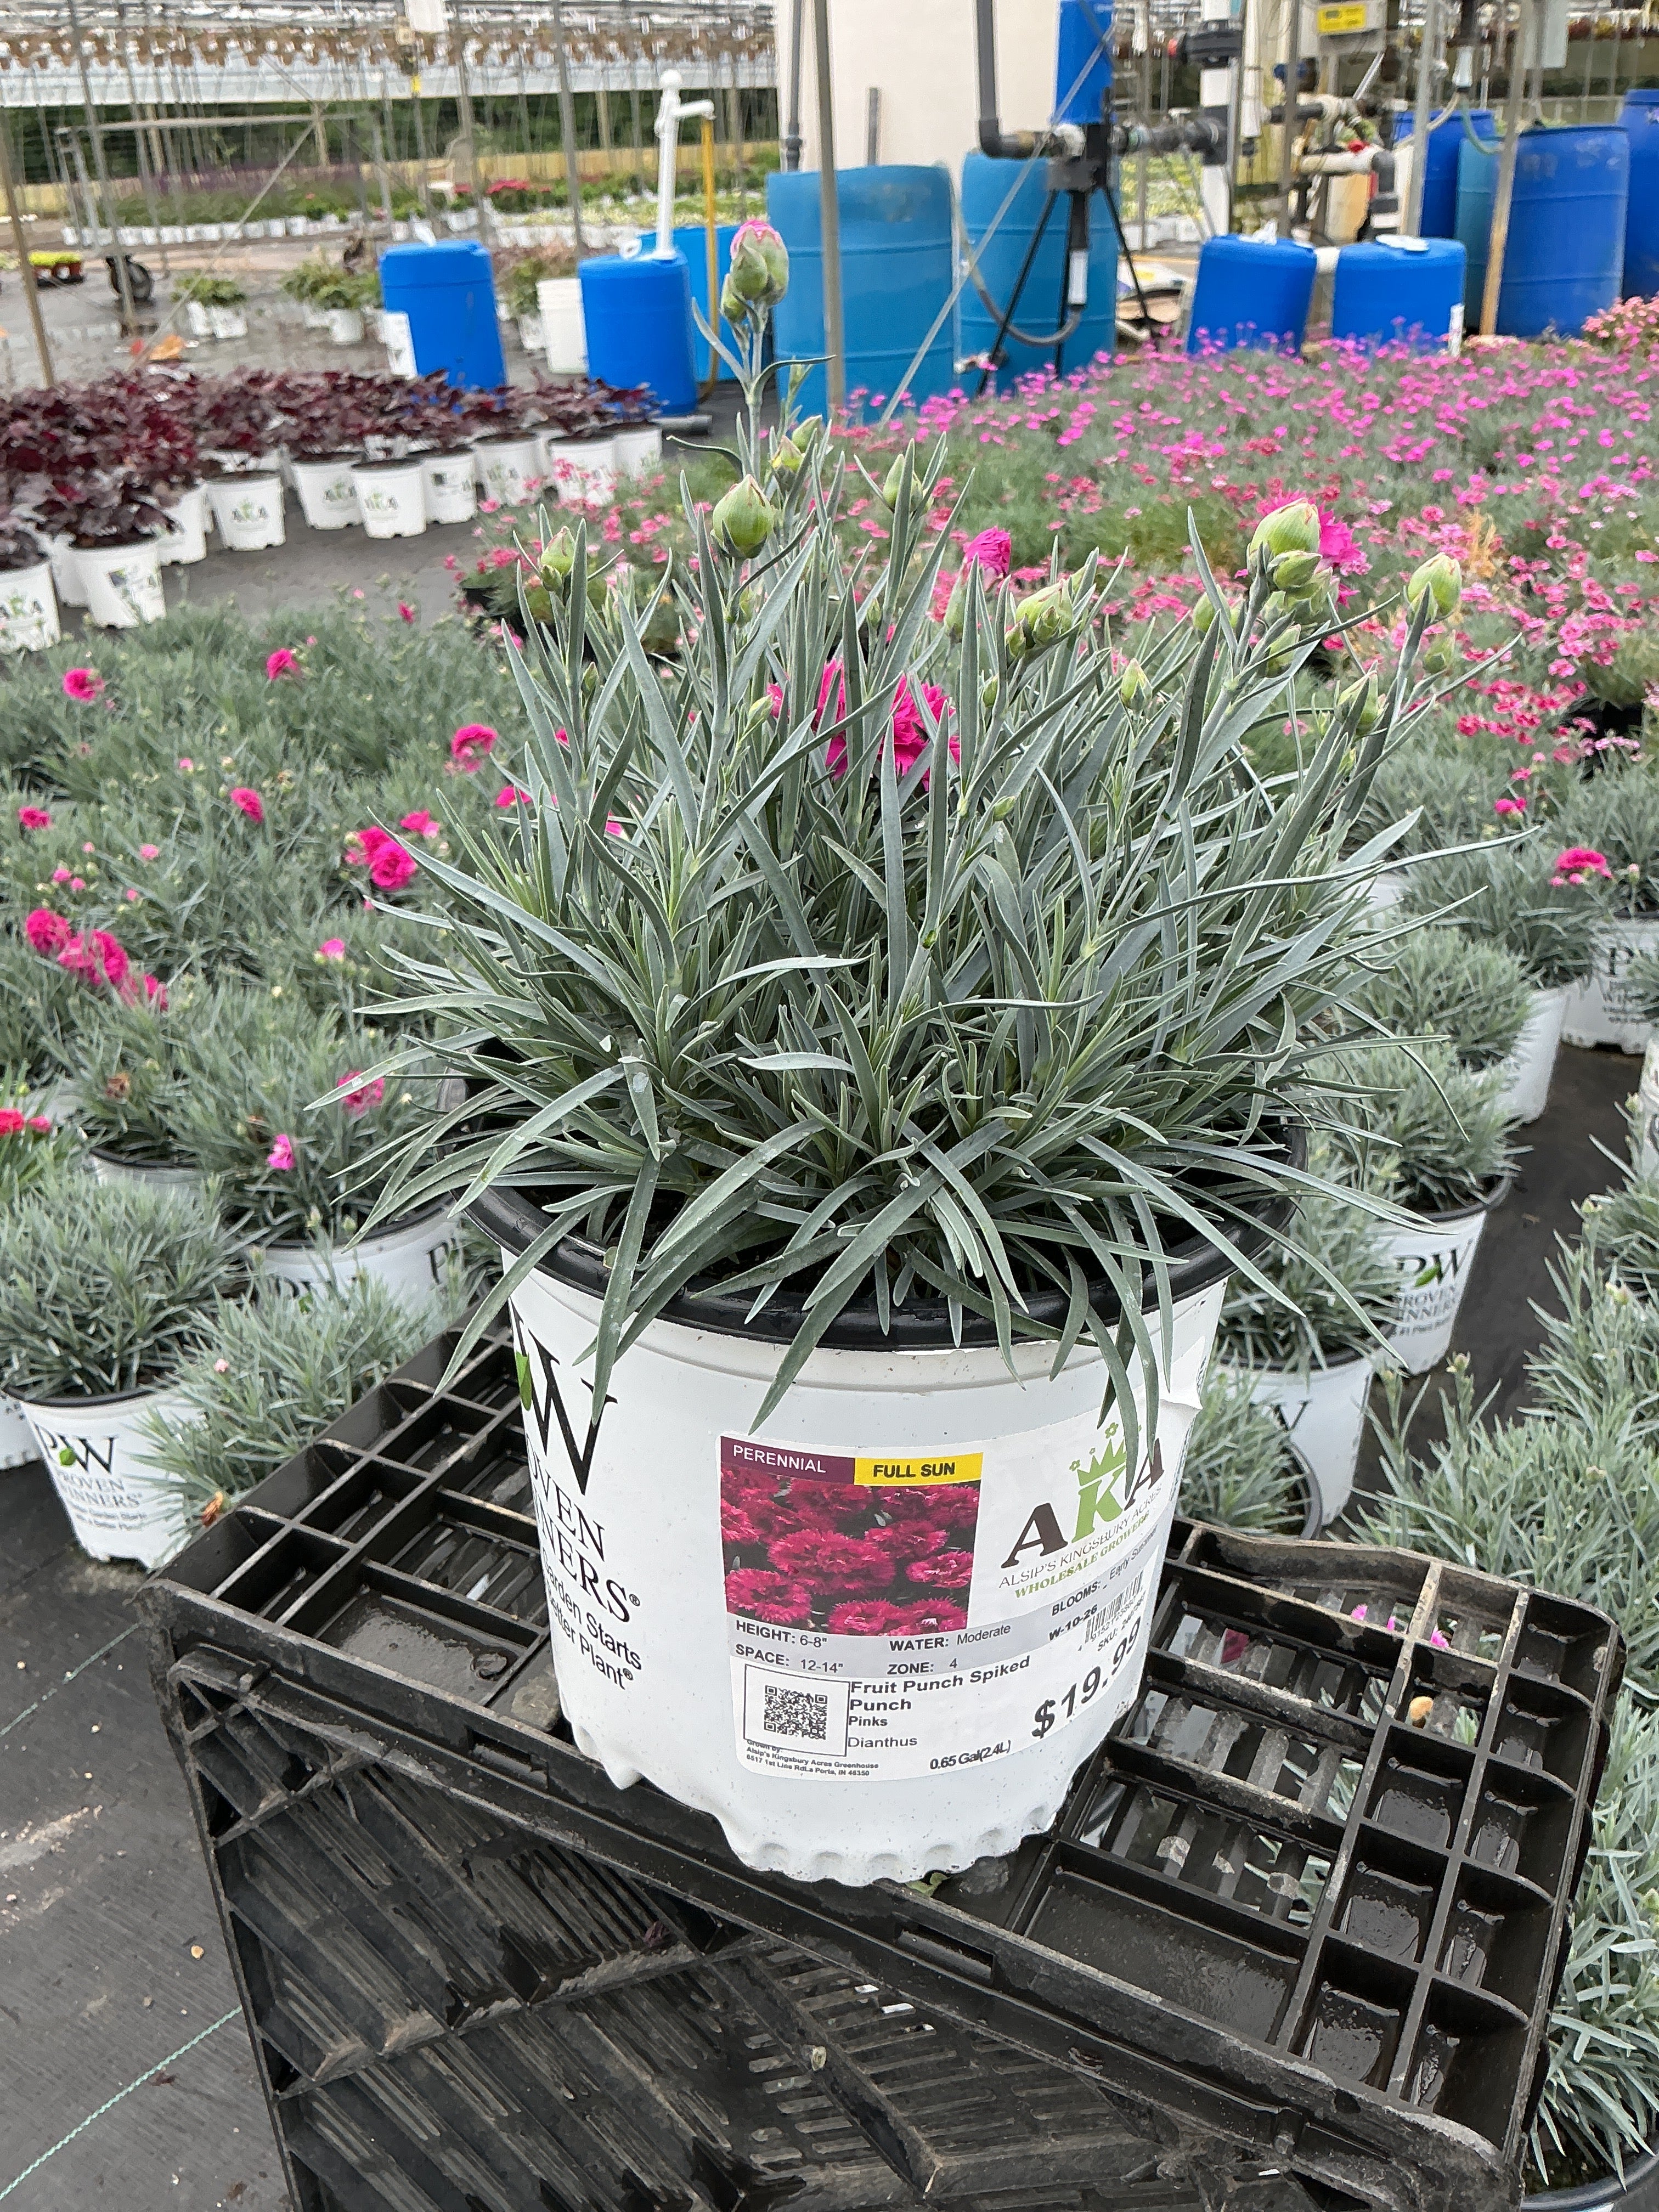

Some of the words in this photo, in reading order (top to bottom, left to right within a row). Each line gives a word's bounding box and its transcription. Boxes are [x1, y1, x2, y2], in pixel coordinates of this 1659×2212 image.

[733, 1444, 826, 1474] PERENNIAL
[873, 1464, 916, 1478] FULL
[921, 1462, 956, 1477] SUN
[1001, 1437, 1165, 1569] AKA
[1060, 1514, 1131, 1567] KINGSBURY
[1014, 1553, 1098, 1599] WHOLESALE
[1052, 1580, 1102, 1617] BLOOMS:
[1109, 1557, 1130, 1581] Early
[542, 1547, 582, 1625] Garden
[586, 1612, 642, 1671] Starts
[1049, 1604, 1098, 1642] W-10-26
[736, 1620, 795, 1644] HEIGHT:
[800, 1634, 827, 1648] 6-8"
[889, 1637, 949, 1651] WATER:
[956, 1624, 1011, 1645] Moderate
[735, 1644, 789, 1667] SPACE:
[800, 1658, 844, 1673] 12-14"
[887, 1662, 934, 1675] ZONE:
[949, 1658, 958, 1669] 4
[851, 1681, 898, 1694] Fruit
[903, 1675, 963, 1693] Punch
[969, 1655, 1031, 1684] Spiked
[1031, 1616, 1141, 1739] $19.99
[850, 1699, 912, 1711] Punch
[848, 1716, 888, 1726] Pinks
[848, 1736, 918, 1748] Dianthus
[772, 1753, 809, 1765] Kingsbury
[777, 1762, 793, 1770] Line
[929, 1754, 957, 1770] 0.65
